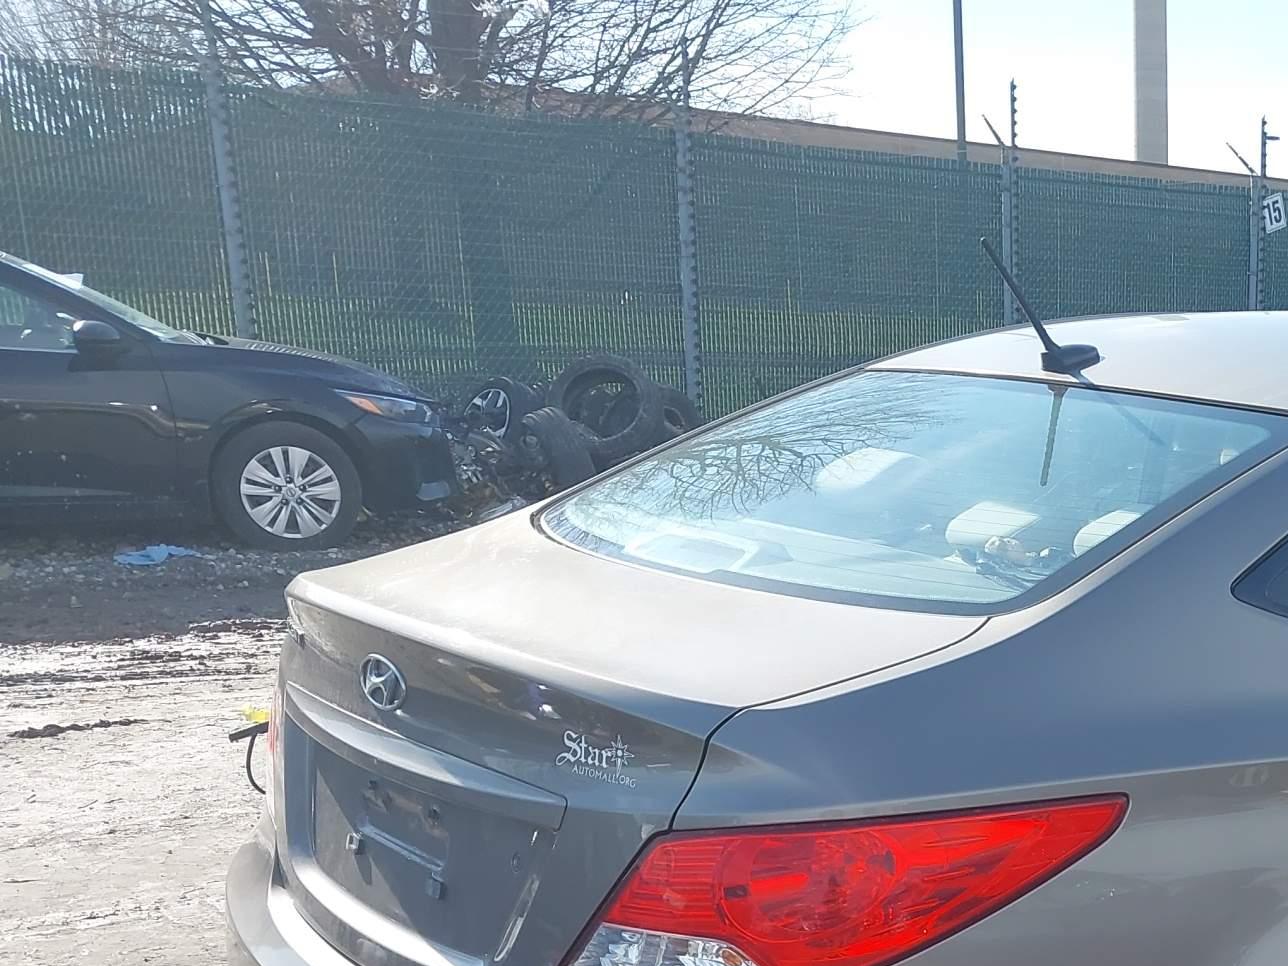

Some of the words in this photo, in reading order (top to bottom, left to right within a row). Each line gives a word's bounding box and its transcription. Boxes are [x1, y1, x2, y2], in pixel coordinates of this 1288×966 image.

[1263, 200, 1283, 226] 15
[556, 730, 612, 768] Star
[572, 765, 637, 788] AUTOMALL.ORG
